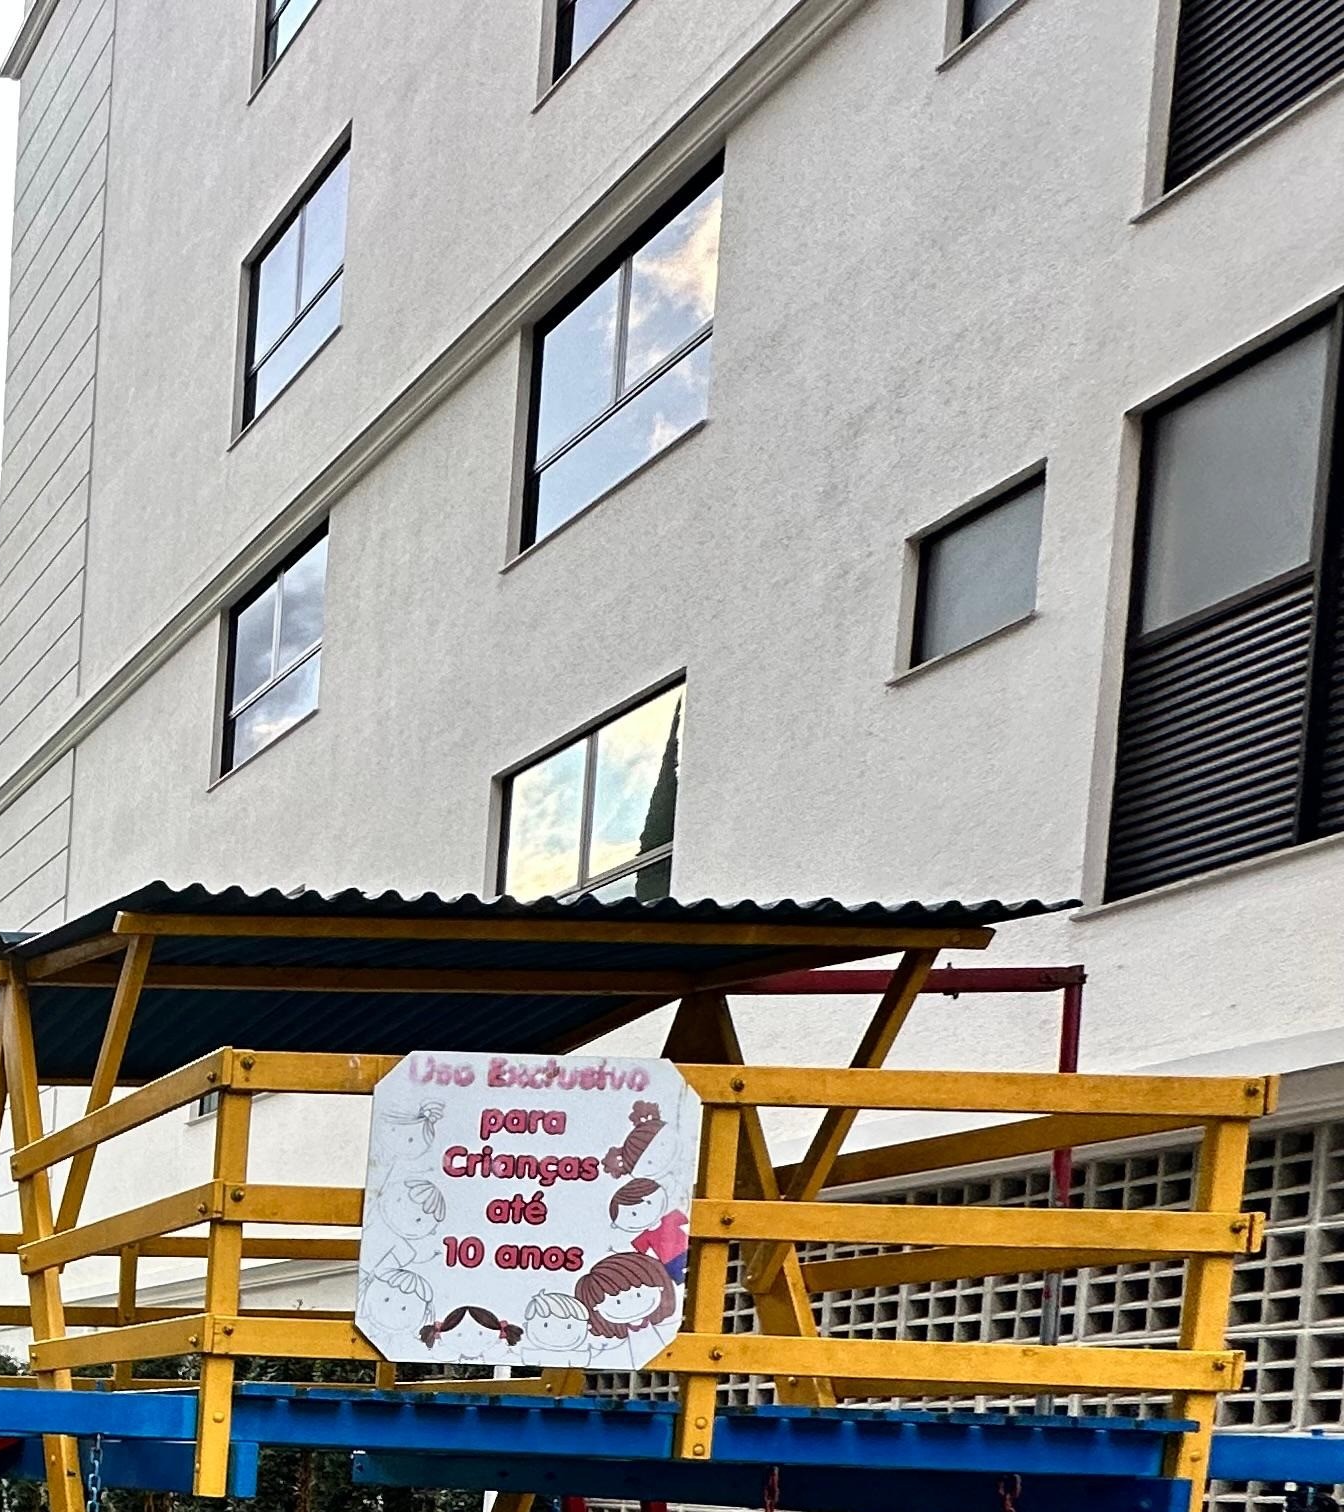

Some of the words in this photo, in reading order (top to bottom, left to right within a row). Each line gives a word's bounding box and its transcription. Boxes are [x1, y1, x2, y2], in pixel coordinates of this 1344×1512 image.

[480, 1108, 567, 1141] para
[442, 1145, 600, 1187] Crianças
[486, 1191, 548, 1225] até
[443, 1235, 485, 1268] 10
[495, 1244, 584, 1272] anos
